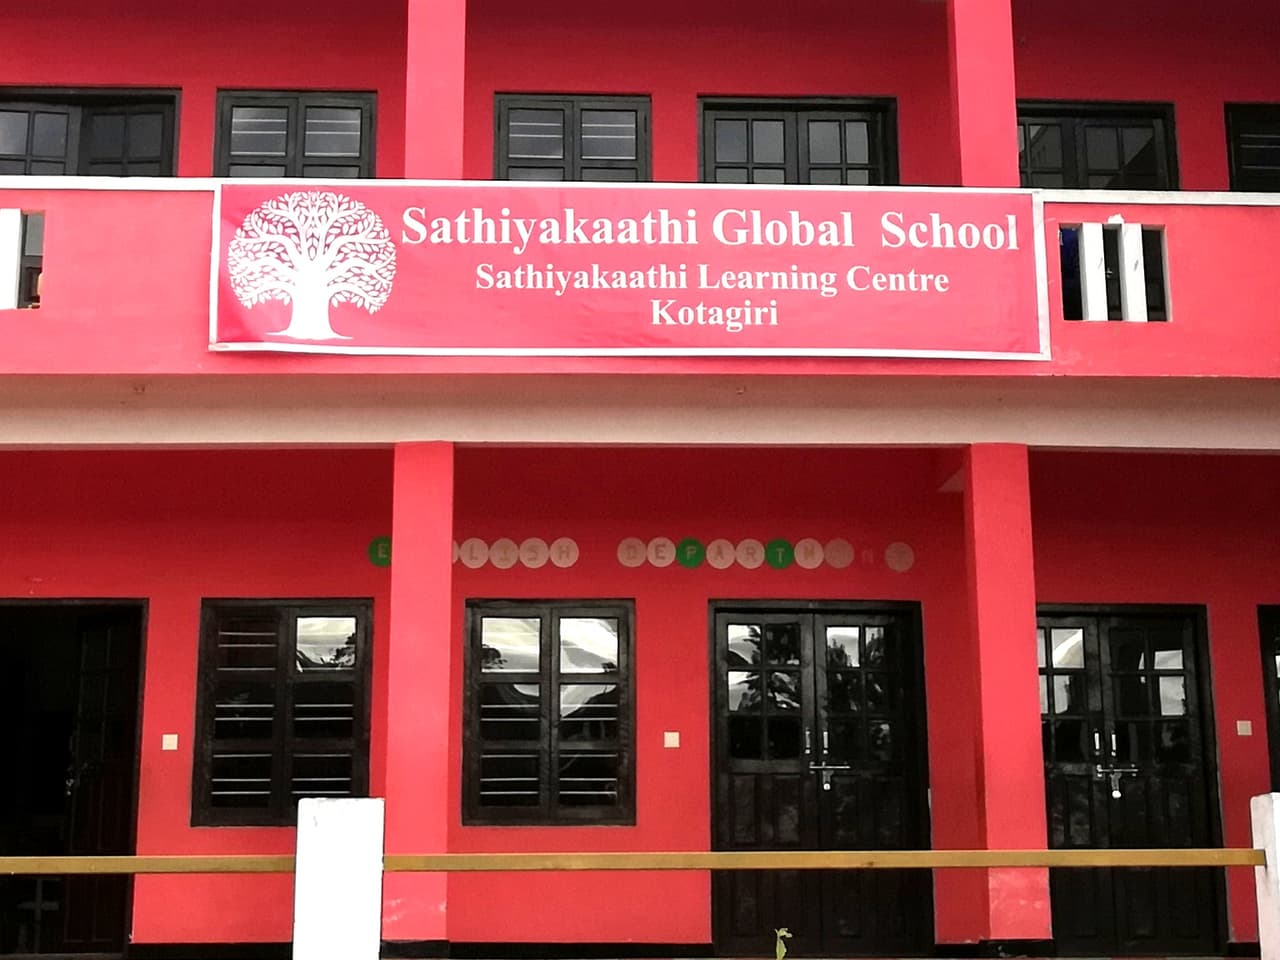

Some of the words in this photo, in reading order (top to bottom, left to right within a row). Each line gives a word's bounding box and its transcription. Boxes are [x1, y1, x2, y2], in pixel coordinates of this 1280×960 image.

[401, 206, 699, 256] Sathiyakaathi
[712, 208, 856, 248] Global
[880, 211, 1020, 251] School
[476, 262, 689, 298] Sathiyakaathi
[697, 263, 838, 299] Learning
[846, 265, 950, 294] Centre
[650, 299, 779, 334] Kotagiri
[375, 541, 573, 563] ELISH
